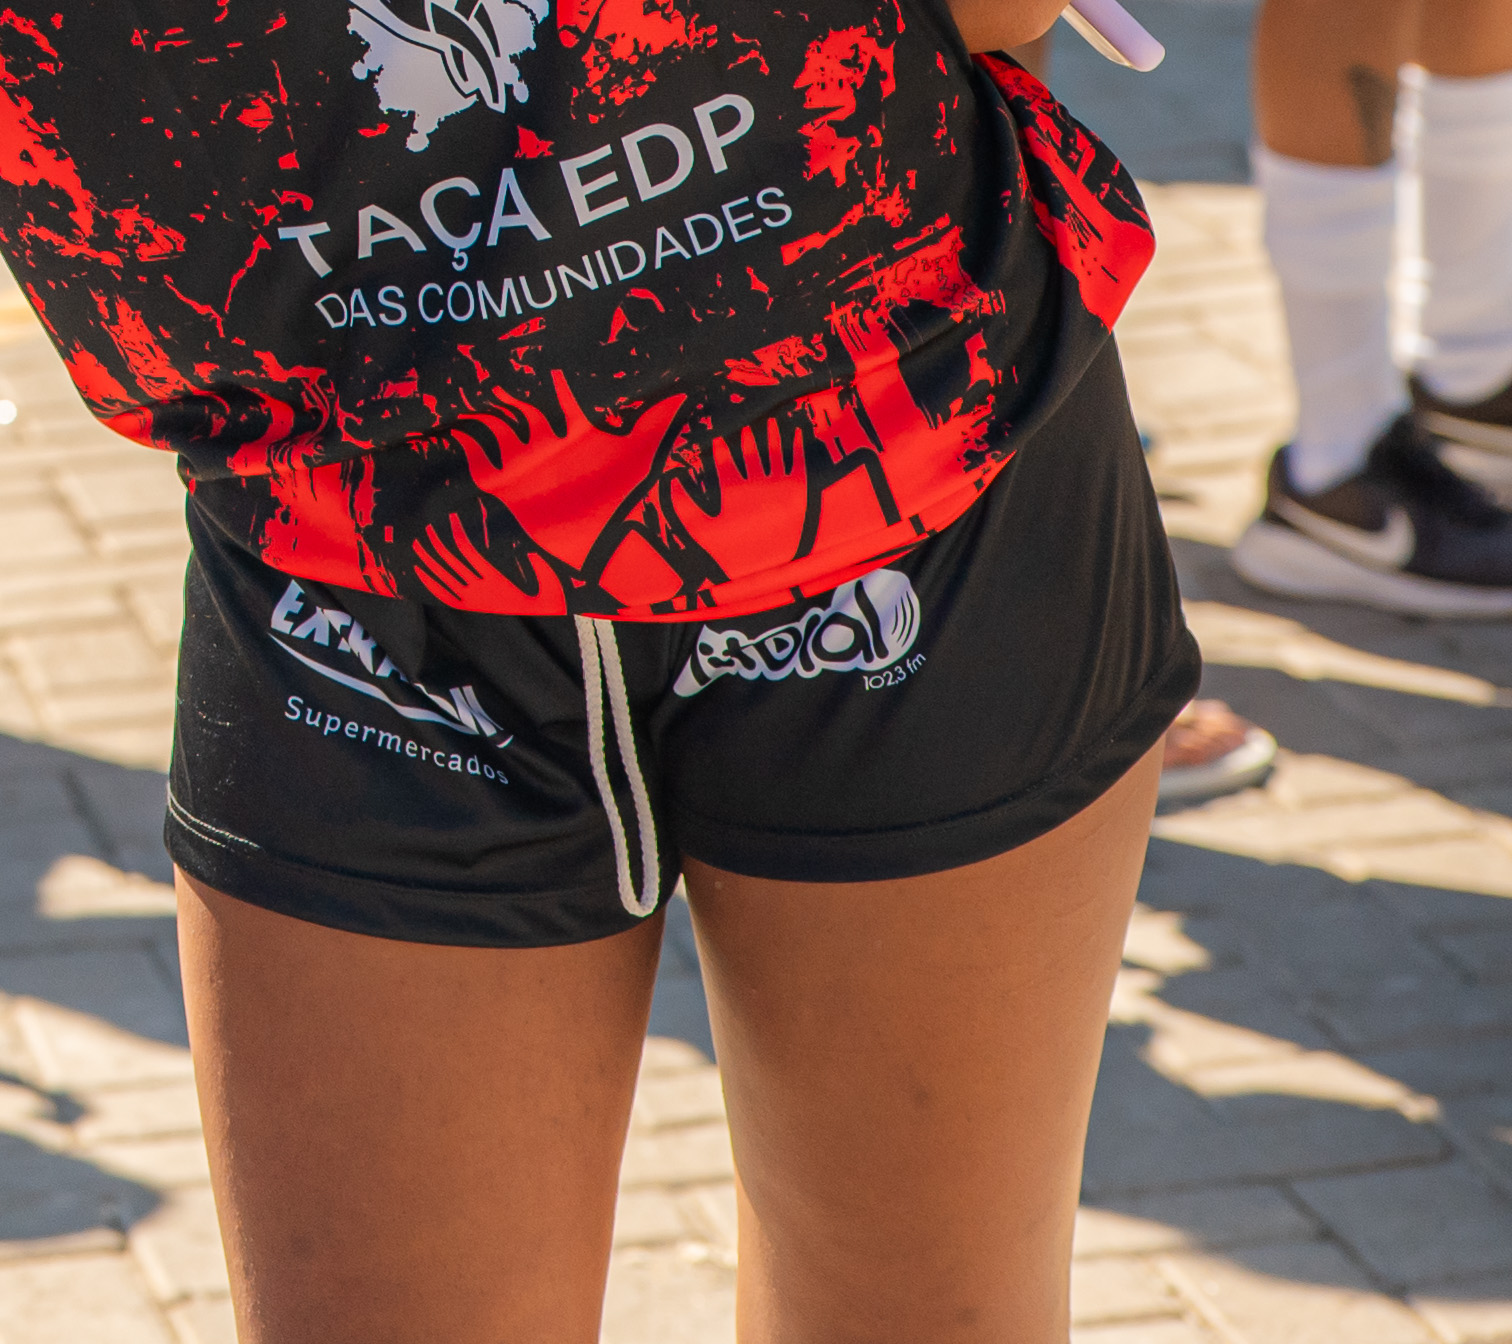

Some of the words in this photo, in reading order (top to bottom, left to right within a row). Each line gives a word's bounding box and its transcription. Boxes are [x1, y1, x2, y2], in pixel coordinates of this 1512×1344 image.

[276, 166, 553, 279] TAÇA
[559, 93, 756, 228] EDP
[314, 285, 407, 329] DAS
[417, 186, 793, 325] COMUNIDADES
[284, 694, 510, 785] Supermercados
